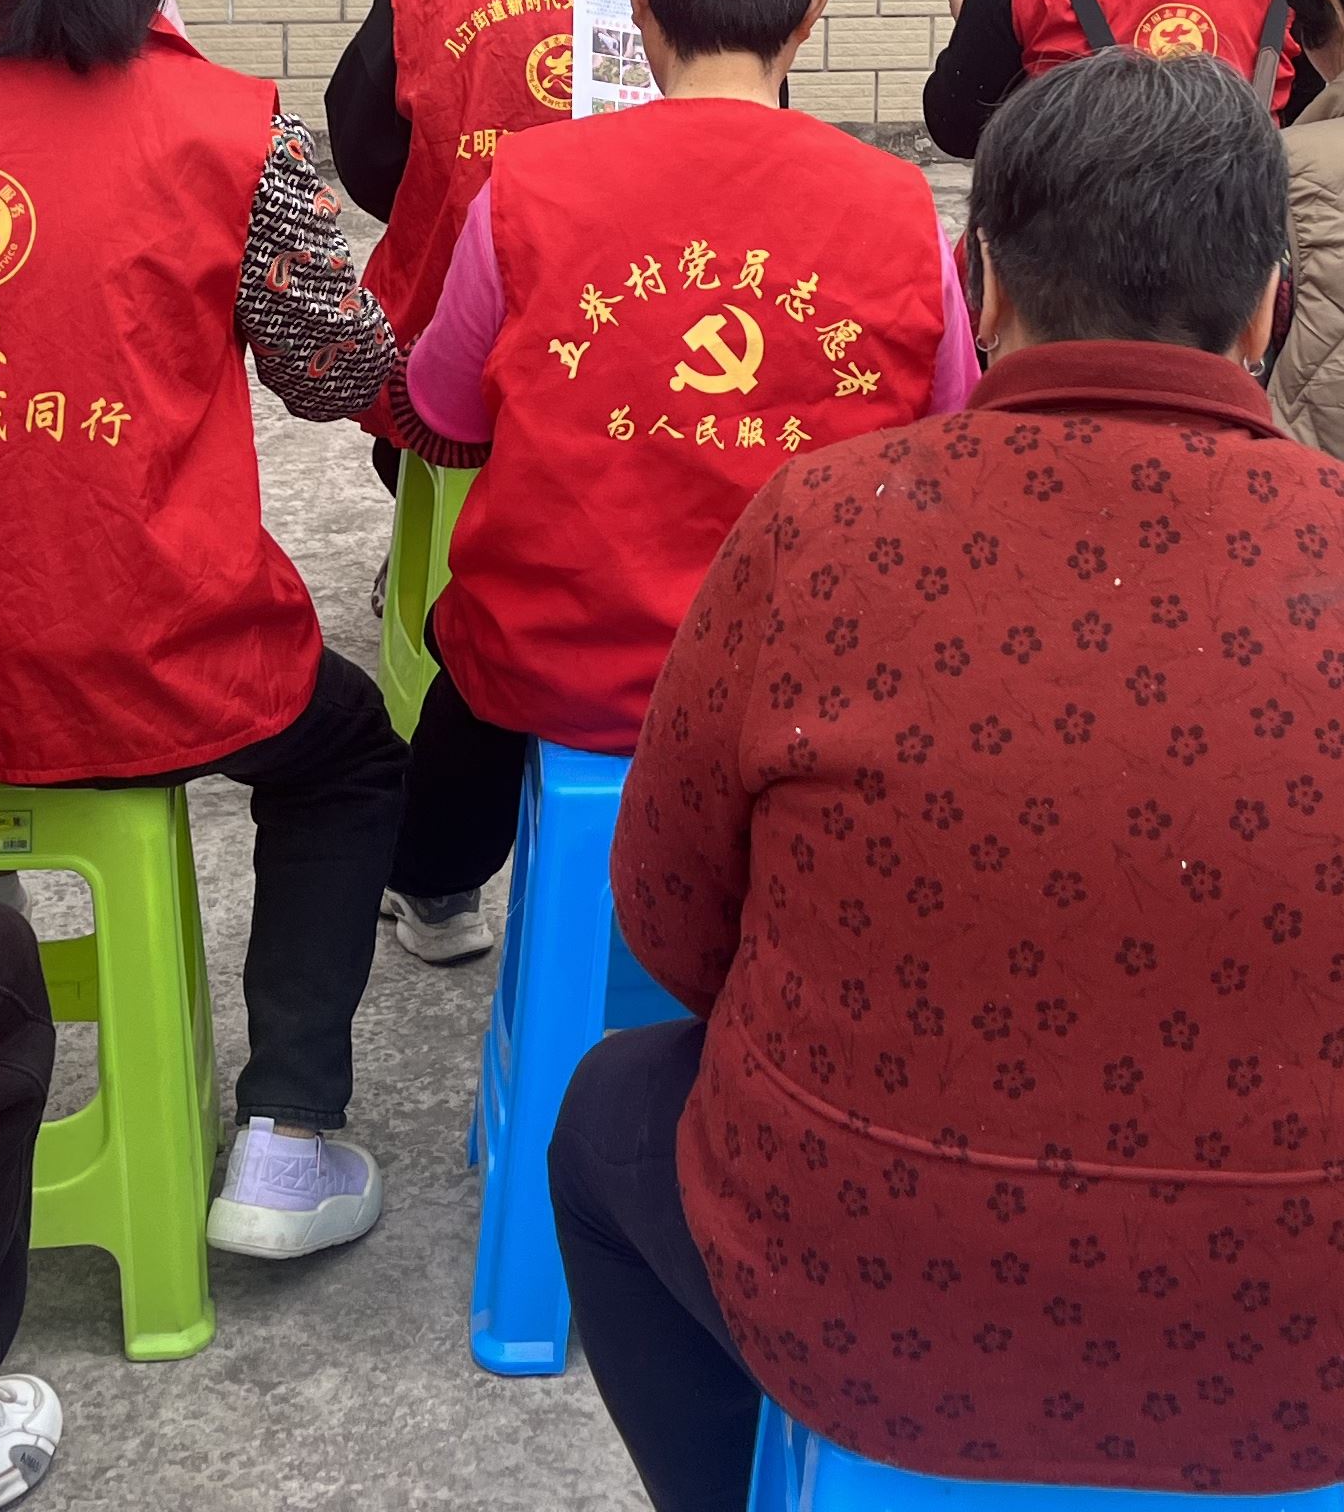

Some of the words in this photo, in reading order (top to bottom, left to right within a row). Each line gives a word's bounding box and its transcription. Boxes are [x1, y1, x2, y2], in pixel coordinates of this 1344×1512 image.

[456, 129, 514, 160] 文明
[607, 405, 812, 452] 为人民服务
